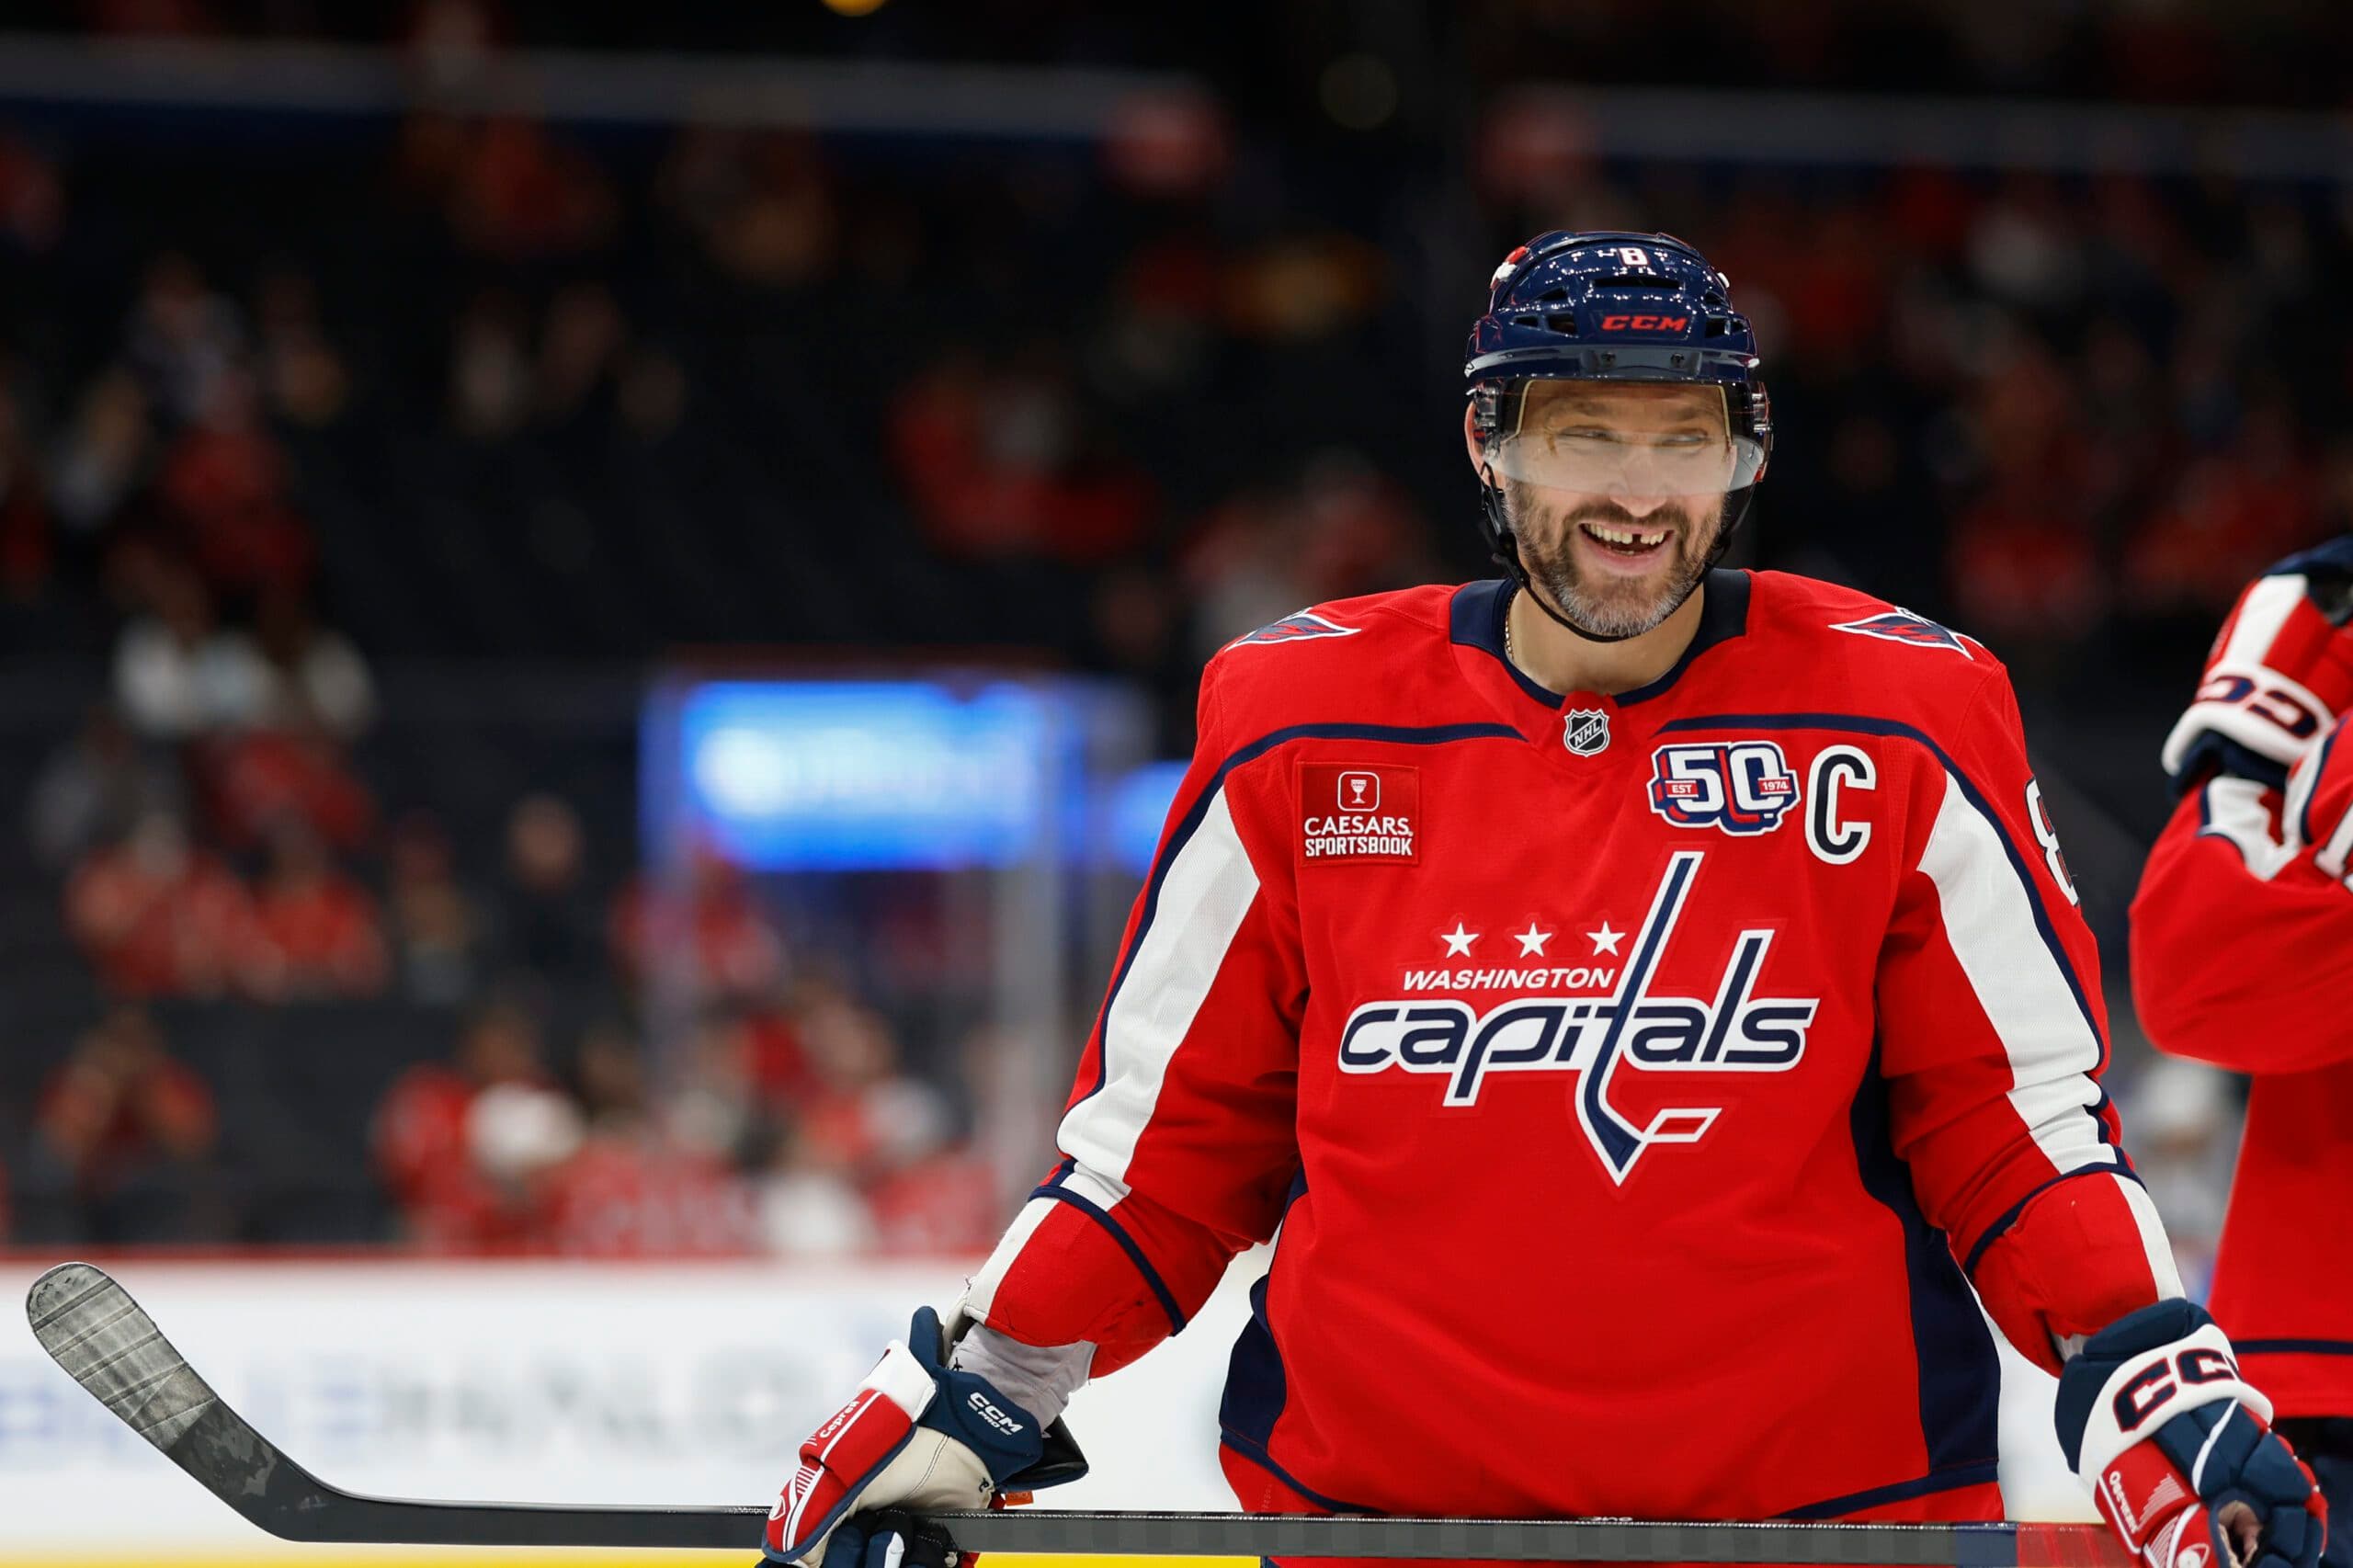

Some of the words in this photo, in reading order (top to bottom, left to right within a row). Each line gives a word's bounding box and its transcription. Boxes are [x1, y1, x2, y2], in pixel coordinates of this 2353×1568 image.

[1619, 246, 1649, 267] 8
[1601, 315, 1688, 332] CCM
[1574, 722, 1601, 747] NHL
[1668, 747, 1784, 812] 50
[1672, 785, 1692, 794] EST
[1762, 781, 1789, 791] 1974
[1804, 744, 1876, 865] C
[1303, 816, 1410, 836] CAESARS
[1305, 835, 1413, 857] SPORTSBOOK
[1404, 968, 1615, 991] WASHINGTON
[1337, 851, 1821, 1187] capitals
[2113, 1347, 2241, 1433] CC
[971, 1392, 1024, 1433] CCM
[978, 1411, 1000, 1428] PRO
